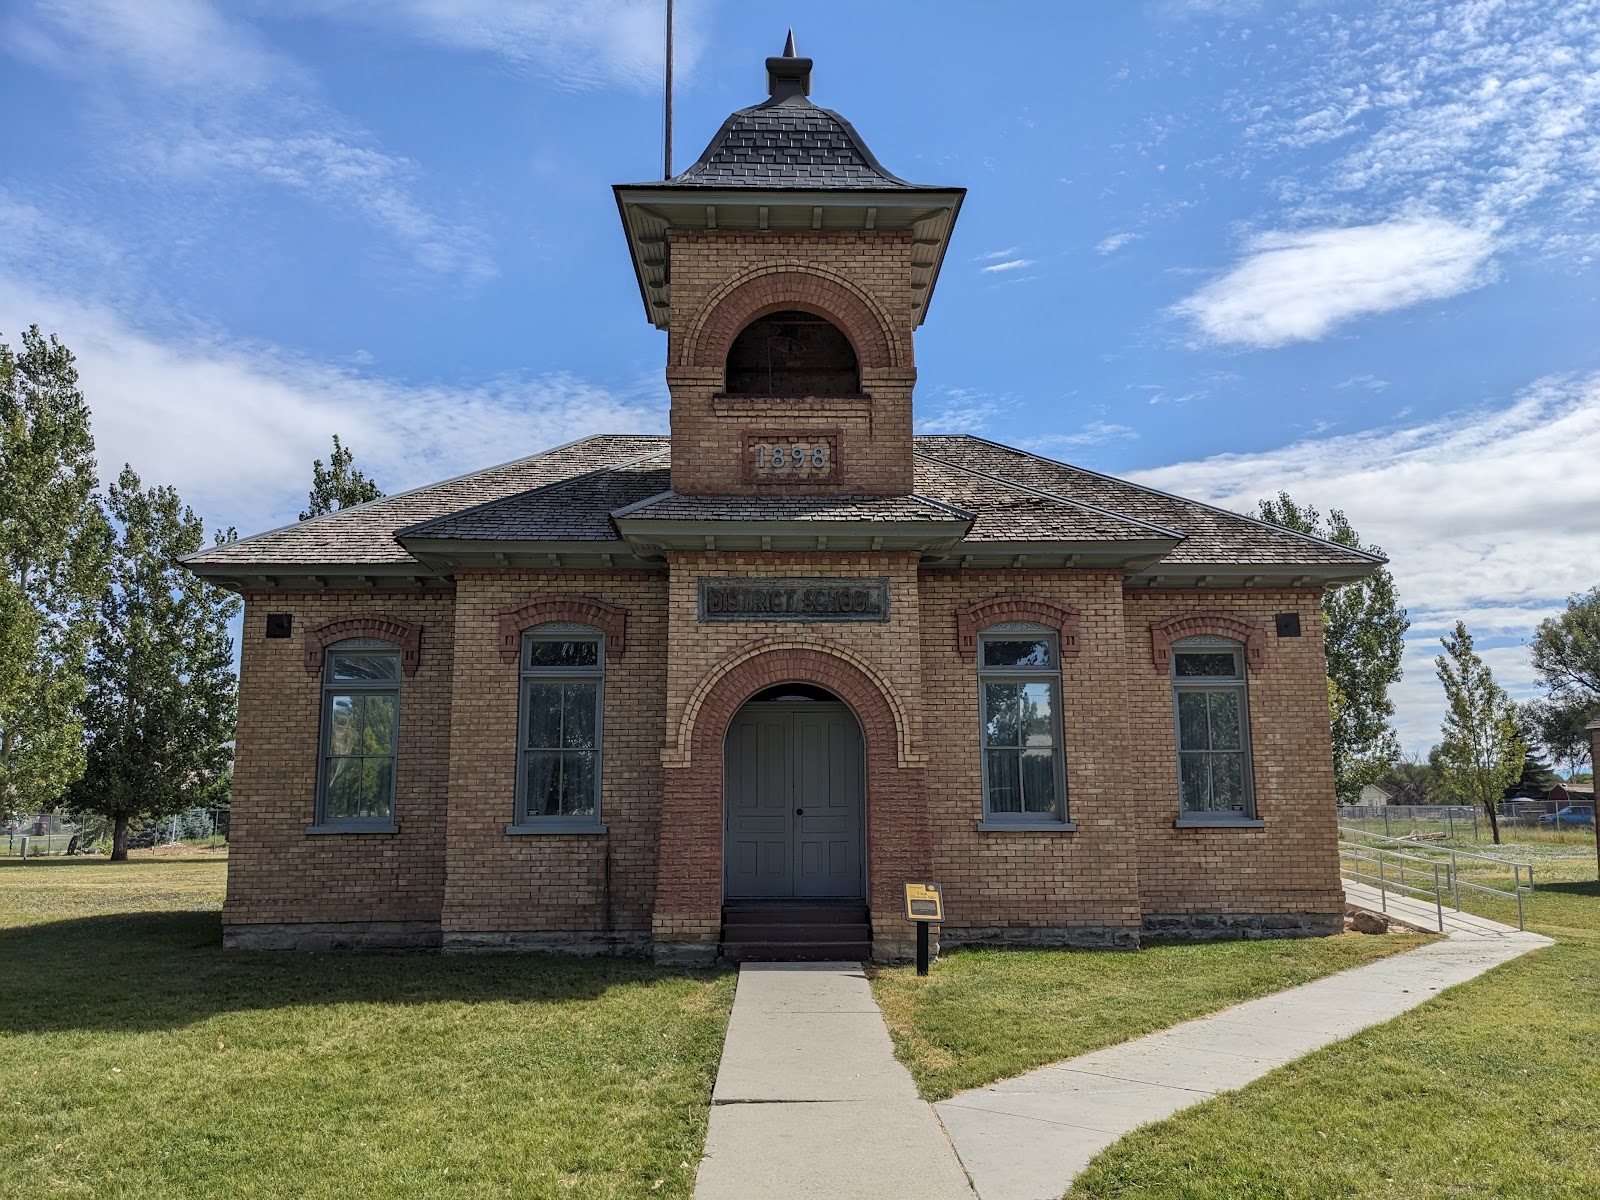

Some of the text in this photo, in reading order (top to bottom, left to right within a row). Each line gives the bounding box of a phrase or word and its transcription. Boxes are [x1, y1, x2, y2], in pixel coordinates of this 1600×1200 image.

[759, 446, 826, 468] 1898
[709, 589, 879, 613] DISTRICT SCHOOL
